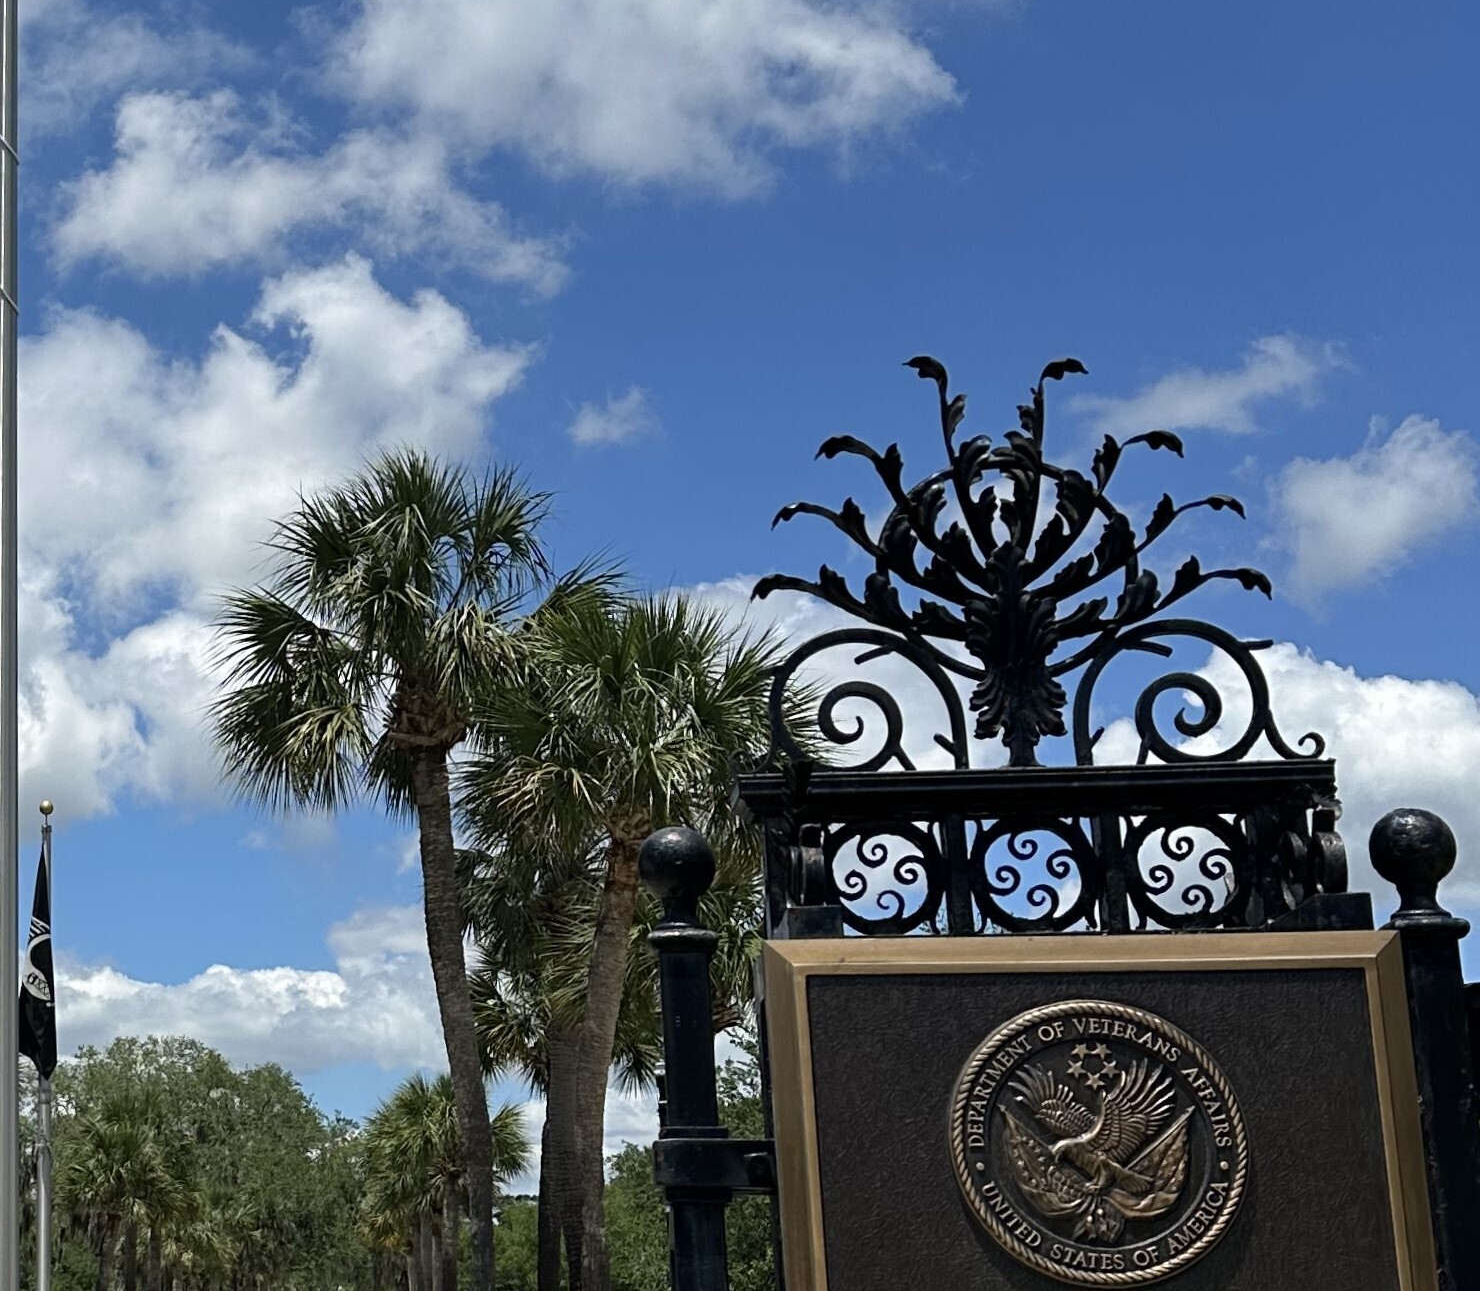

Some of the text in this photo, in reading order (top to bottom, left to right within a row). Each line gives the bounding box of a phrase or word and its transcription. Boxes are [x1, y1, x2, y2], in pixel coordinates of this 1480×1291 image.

[968, 1018, 1232, 1148] DEPARTMENT OF VETERANS AFFAIRS
[981, 1181, 1229, 1270] UNITED STATES OF AMERICA
